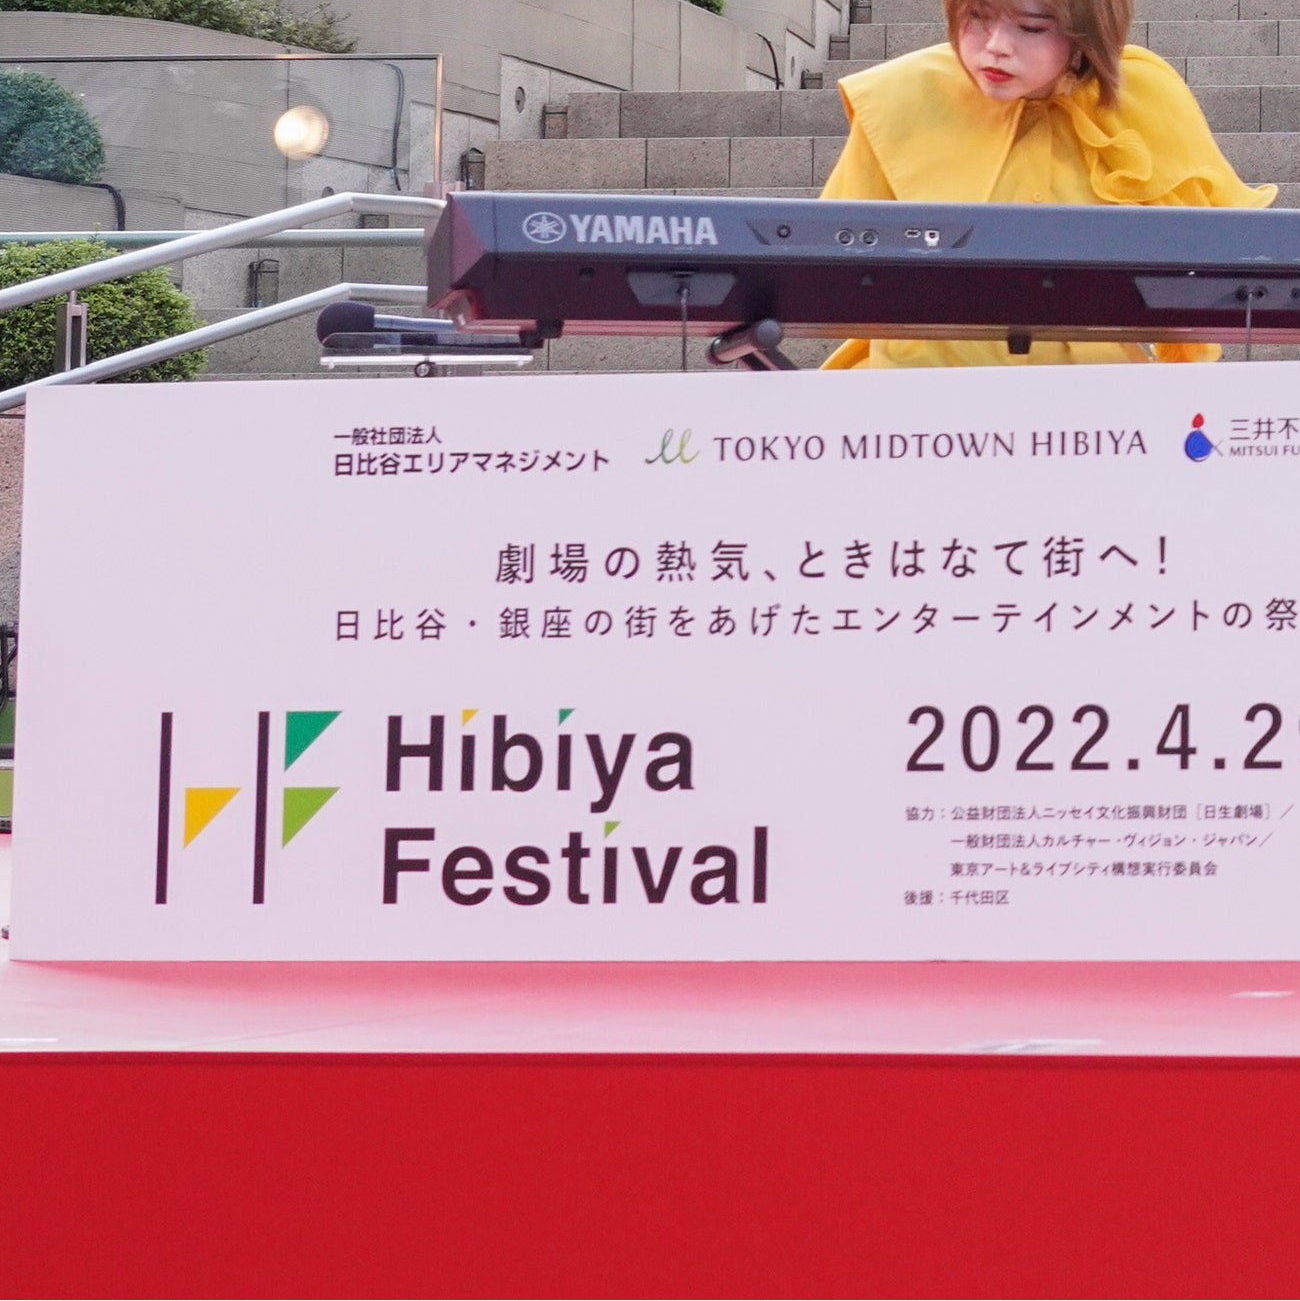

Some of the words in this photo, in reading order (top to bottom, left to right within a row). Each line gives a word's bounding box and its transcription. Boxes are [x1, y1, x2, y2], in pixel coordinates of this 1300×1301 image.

[571, 213, 719, 246] YAMAHA
[334, 426, 443, 447] 一般社団法人
[712, 435, 826, 462] TOKYO
[841, 431, 1015, 460] MIDTOWN
[1031, 429, 1148, 457] HIBIYA
[1229, 445, 1278, 457] MITSUI
[334, 450, 610, 477] 日比谷エリアマネジメント
[386, 707, 695, 814] Hibiya
[382, 820, 769, 907] Festival
